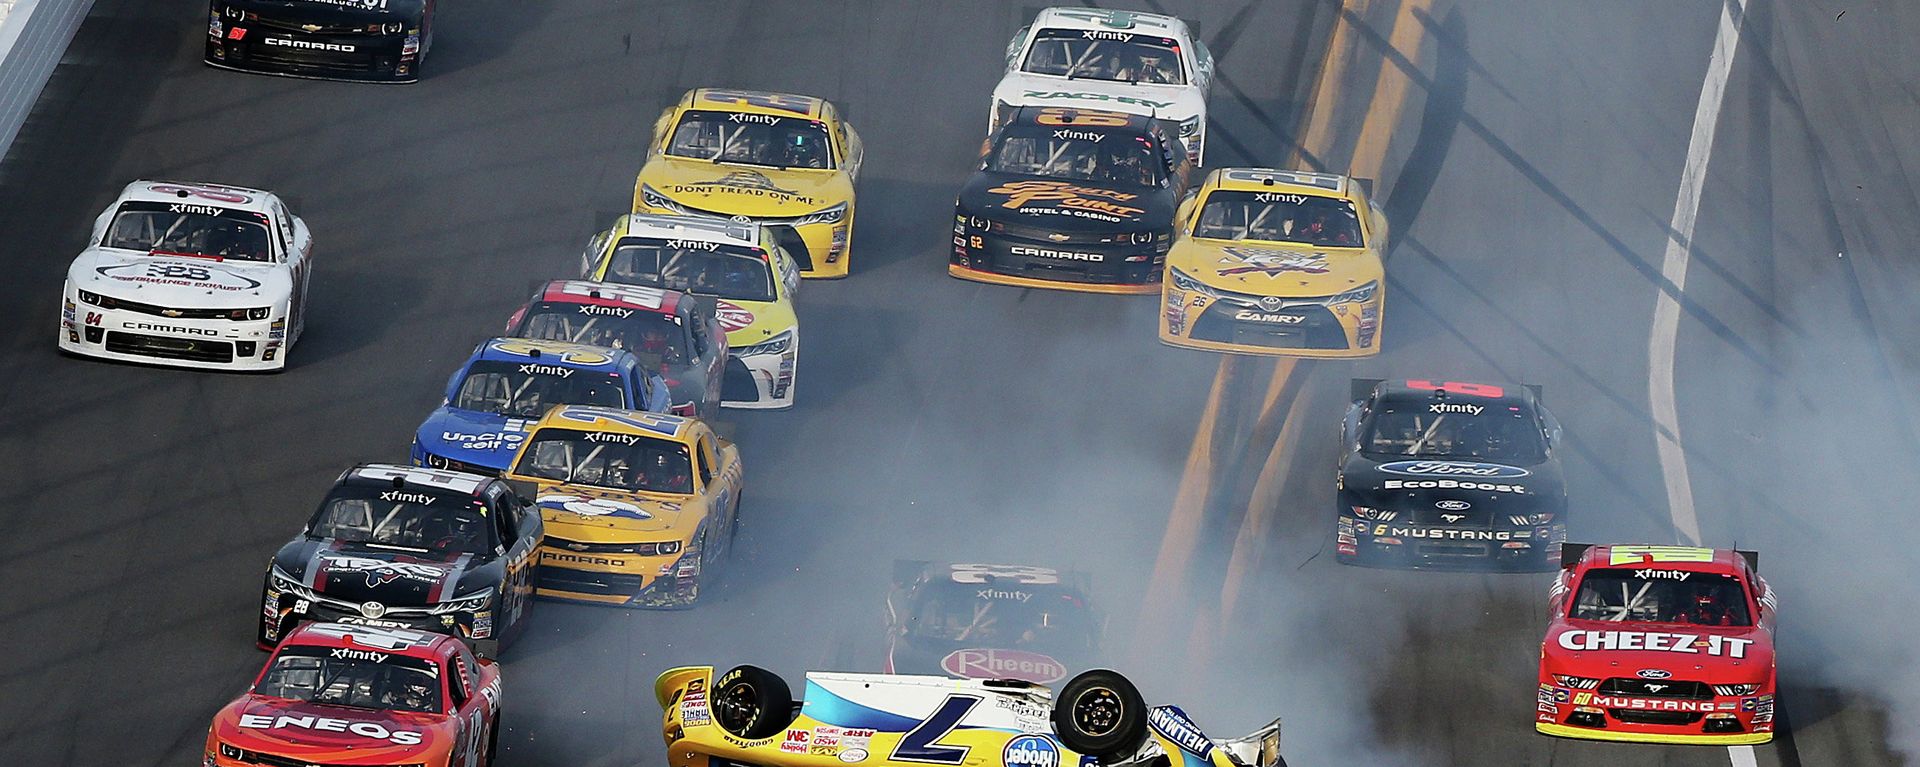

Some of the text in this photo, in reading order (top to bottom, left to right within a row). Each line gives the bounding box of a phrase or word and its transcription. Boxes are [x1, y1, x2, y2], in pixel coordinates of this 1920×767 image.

[1082, 30, 1134, 43] xfinity
[264, 37, 356, 53] CAMARO
[728, 112, 781, 126] xfinity
[1053, 129, 1105, 143] xfinity
[720, 187, 764, 196] TREAD
[769, 192, 790, 202] ON
[795, 197, 815, 205] ME
[1001, 191, 1145, 214] POINT
[1254, 193, 1308, 205] xfinity
[169, 203, 224, 217] xfinity
[1020, 207, 1121, 223] HOTEL & CASINO
[666, 239, 720, 253] xfinity
[970, 235, 983, 249] 62
[1011, 247, 1104, 262] CAMARO
[1192, 296, 1207, 307] 26
[85, 311, 103, 326] 84
[578, 305, 634, 319] xfinity
[1235, 311, 1306, 324] CAMRY
[122, 321, 218, 336] CAMARO
[519, 363, 574, 378] xfinity
[1429, 402, 1484, 415] xfinity
[584, 432, 640, 446] xfinity
[1407, 461, 1500, 476] Ford
[1384, 480, 1525, 494] EcoBoost
[380, 491, 436, 506] xfinity
[1374, 524, 1388, 536] 6
[1392, 527, 1510, 540] MUSTANG
[542, 552, 625, 567] AMARO
[1634, 568, 1691, 581] xfinity
[976, 588, 1033, 603] xfinity
[293, 599, 309, 615] 28
[1558, 629, 1753, 659] CHEEZ-IT
[330, 647, 389, 664] xfinity
[958, 650, 1058, 679] Rheem
[1641, 670, 1666, 678] Ford
[1573, 691, 1593, 705] 60
[1593, 696, 1714, 711] MUSTANG
[239, 713, 422, 745] ENEOS
[786, 730, 810, 742] 3M
[842, 730, 875, 738] ARP
[887, 693, 985, 766] 7
[1006, 739, 1054, 767] Kroger
